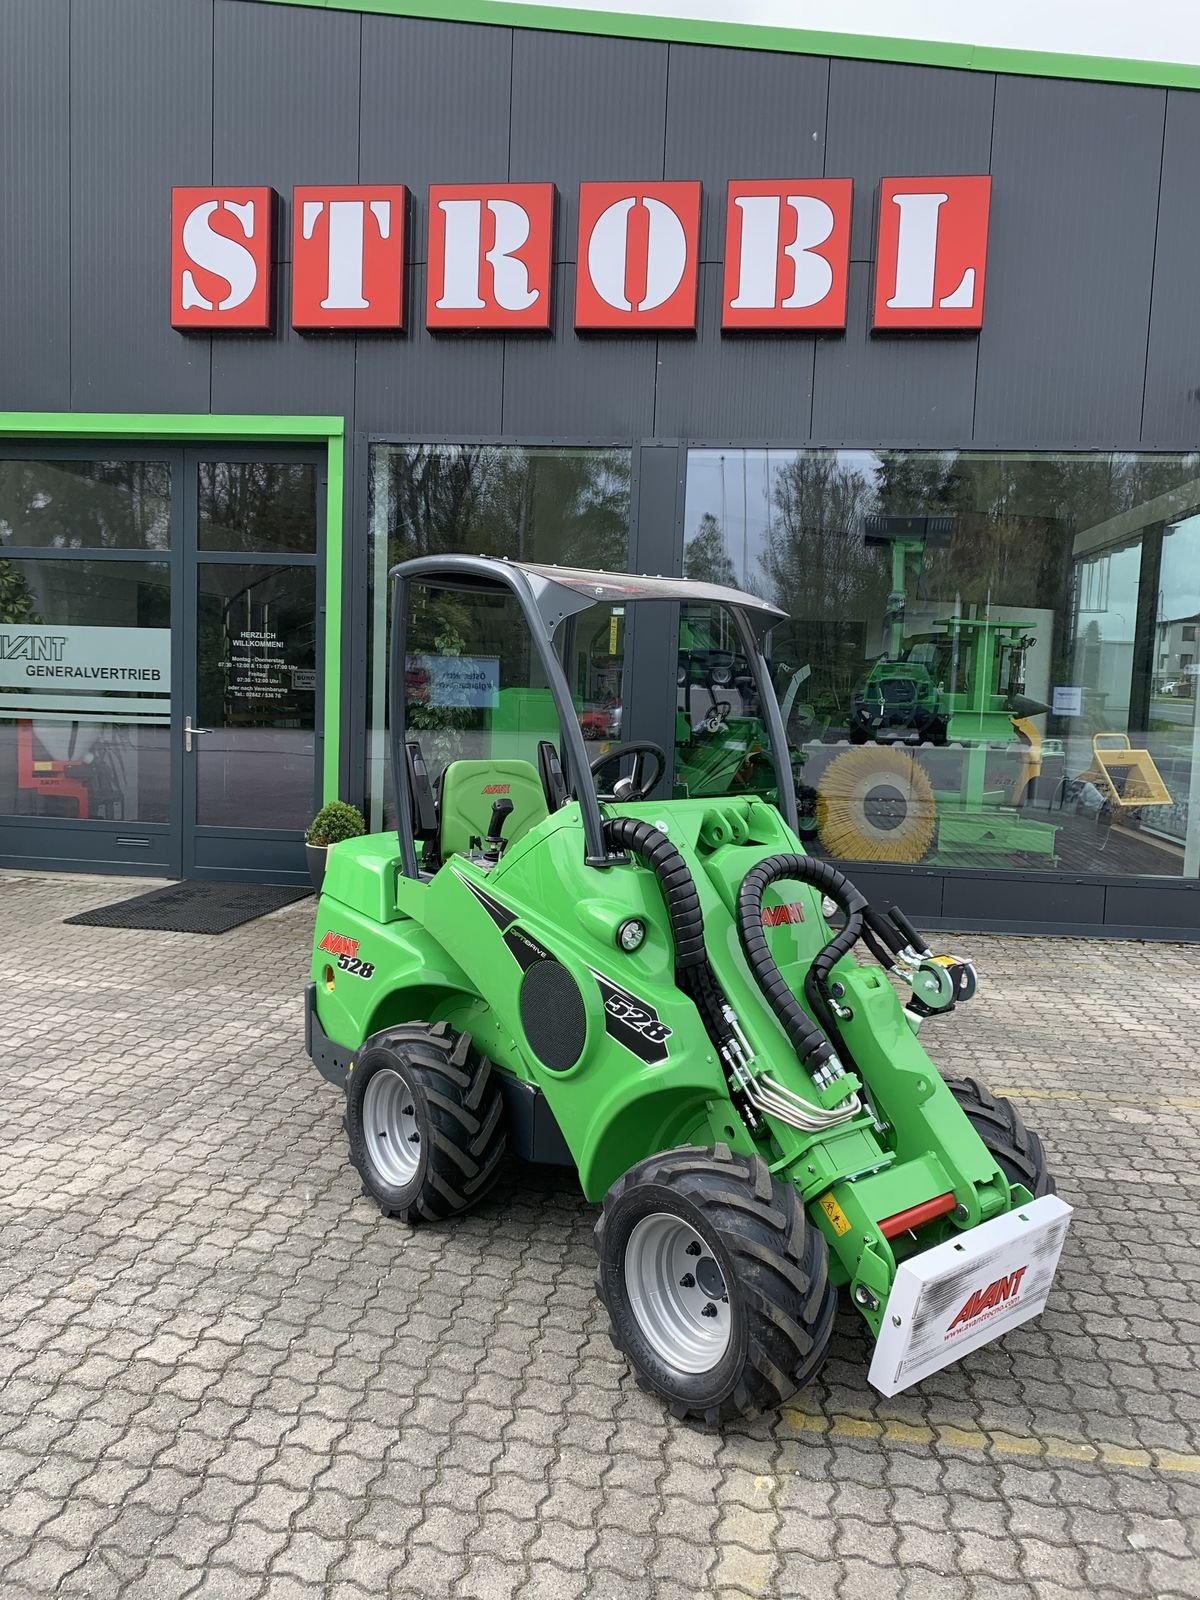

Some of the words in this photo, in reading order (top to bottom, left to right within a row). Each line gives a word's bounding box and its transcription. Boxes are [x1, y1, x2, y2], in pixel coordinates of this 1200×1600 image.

[181, 193, 976, 313] STROBL
[0, 635, 66, 661] VANT
[232, 639, 284, 648] WILLKOMMEN!
[25, 665, 161, 681] GENERALVERTRIEB
[481, 784, 511, 794] AVANT
[761, 902, 805, 927] AVANT
[318, 930, 360, 958] AVANT
[510, 928, 548, 959] OPTIDRIVE
[337, 953, 376, 980] 528
[604, 994, 673, 1043] 528
[946, 1264, 1029, 1332] AVANT
